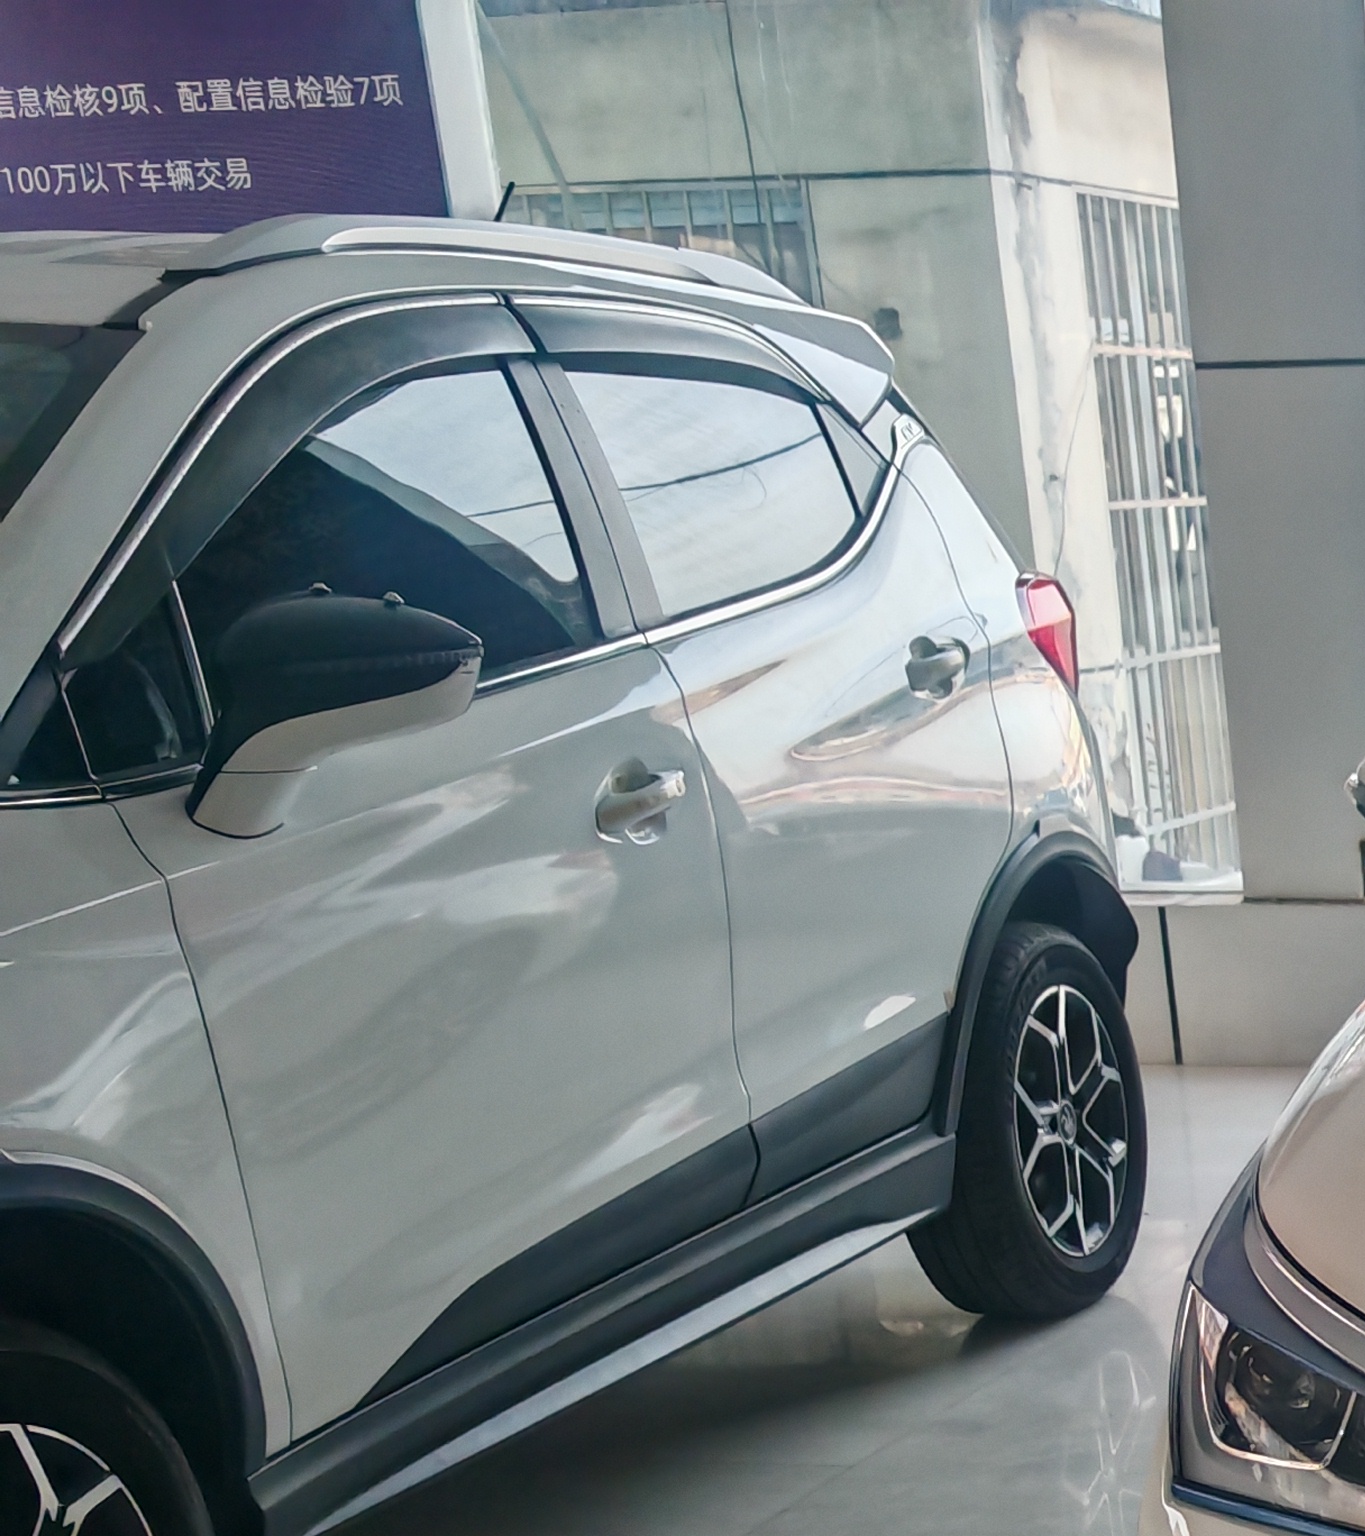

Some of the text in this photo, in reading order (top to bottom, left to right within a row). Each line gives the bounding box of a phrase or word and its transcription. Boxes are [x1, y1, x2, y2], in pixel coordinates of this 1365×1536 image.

[0, 157, 253, 196] 100万以下车辆交易
